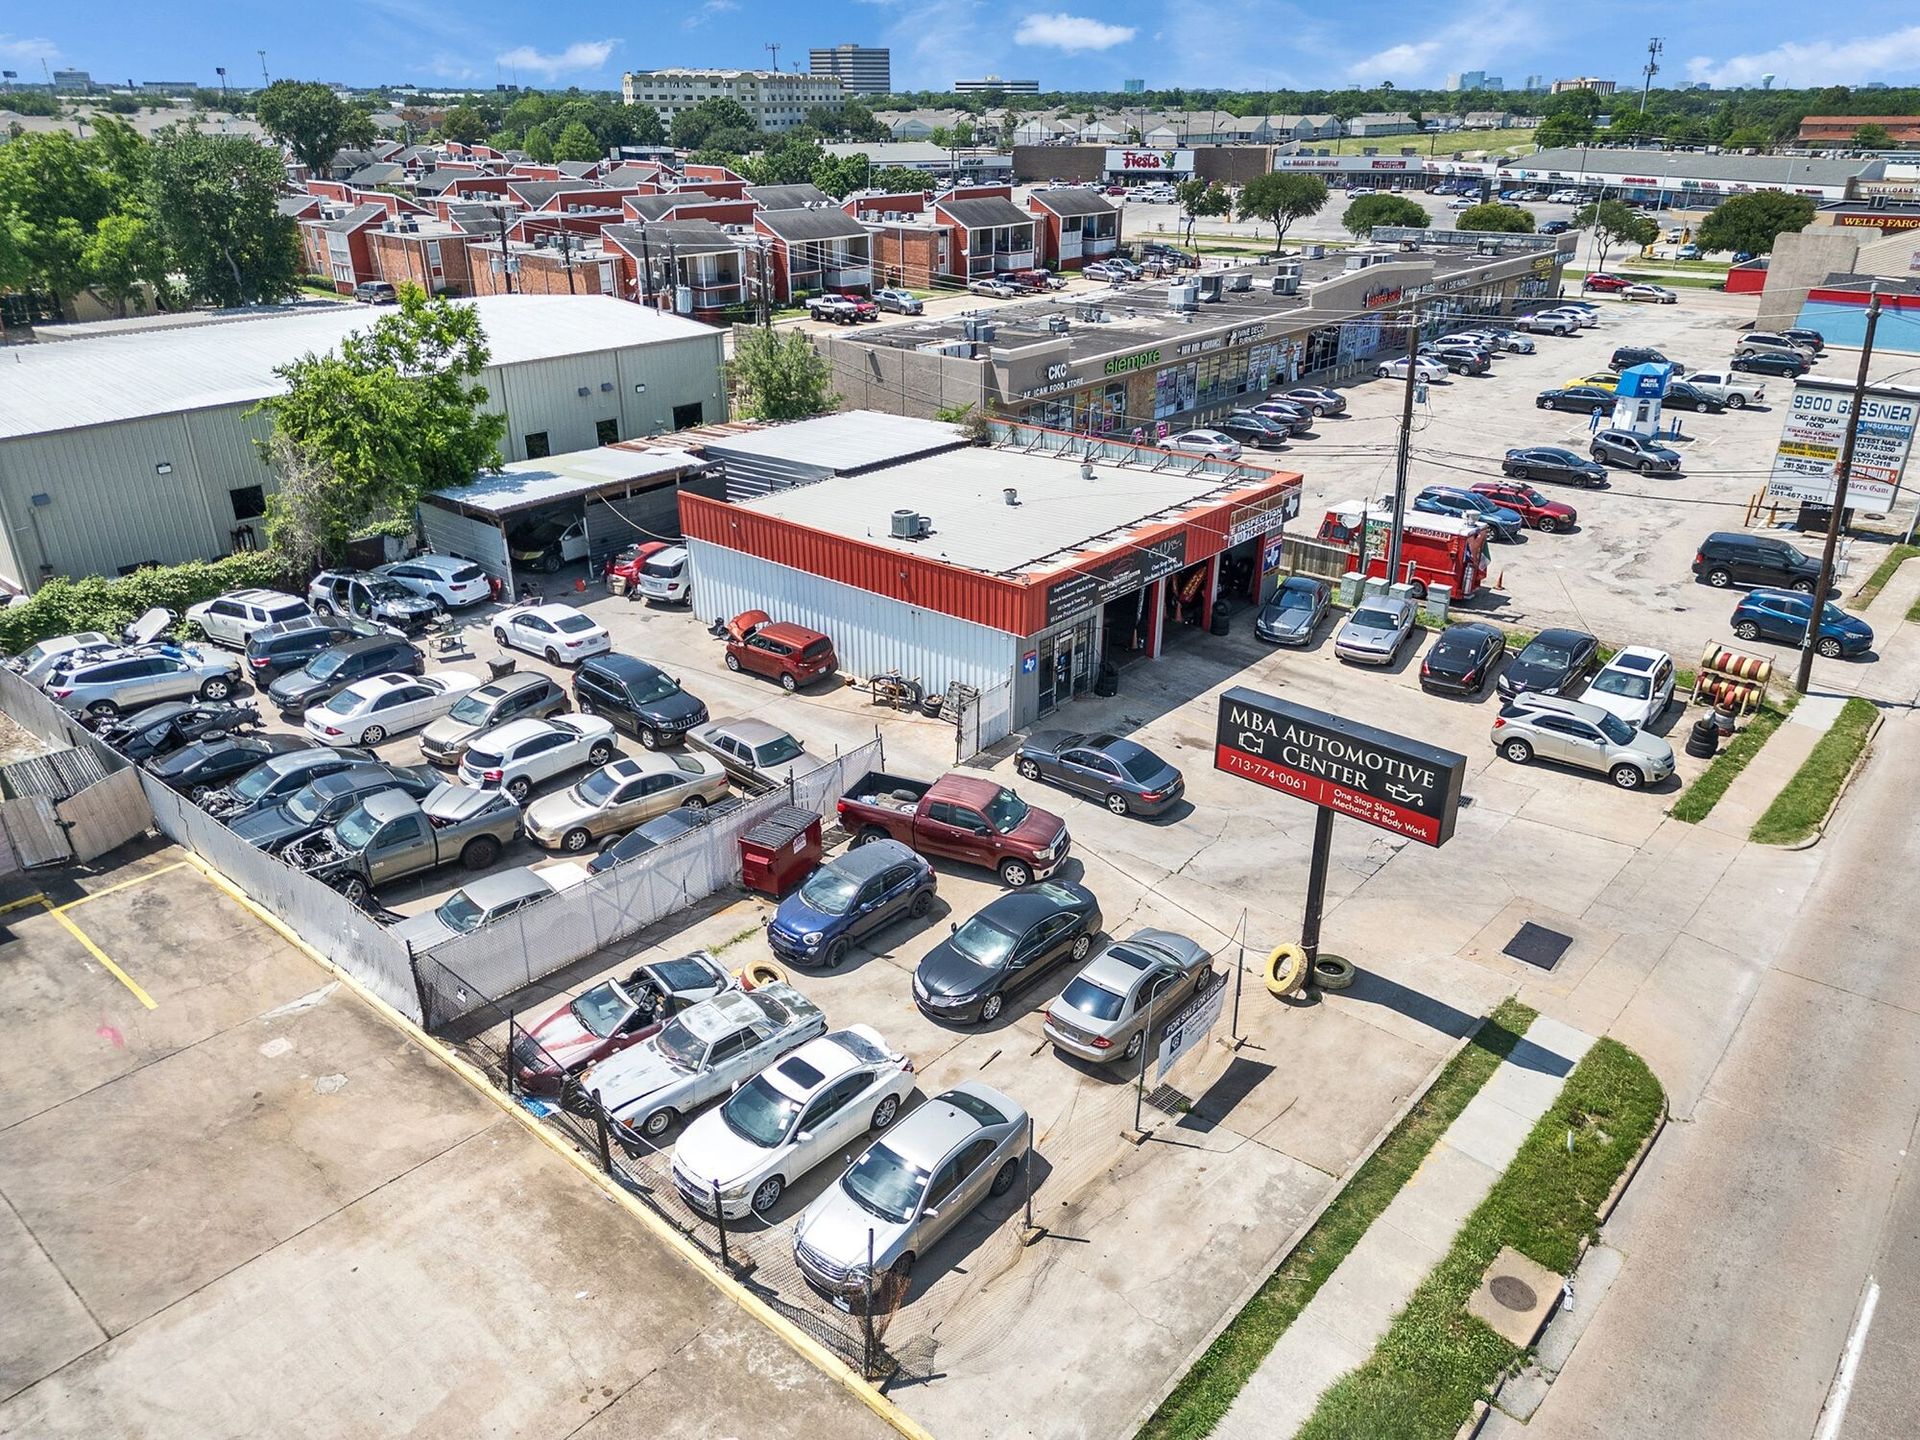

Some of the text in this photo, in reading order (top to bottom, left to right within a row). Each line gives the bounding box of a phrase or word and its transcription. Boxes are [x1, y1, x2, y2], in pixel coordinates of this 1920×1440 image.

[1122, 151, 1160, 169] Fiesta
[1844, 217, 1920, 228] WELLS FARG
[1104, 351, 1162, 375] siempre
[1048, 363, 1067, 380] CKC
[1794, 395, 1833, 412] 9900
[1809, 415, 1839, 425] AFRICAN
[1864, 422, 1911, 433] INSURANCE
[1813, 431, 1840, 439] AFRICAN
[1856, 443, 1896, 453] 13-774-3350
[1881, 439, 1903, 447] NAILS
[1853, 457, 1892, 467] 13-777-3118
[1871, 453, 1901, 463] CASHED
[1771, 484, 1793, 492] LEASING
[1769, 490, 1823, 502] 281-467-3535
[1237, 507, 1282, 532] INSPECTION
[1230, 706, 1435, 789] MBA AUTOMOTIVE
[1282, 746, 1370, 791] CENTER
[1334, 788, 1396, 817] One Stop Shop
[1332, 798, 1427, 838] Mechanic & Body Work
[1166, 1020, 1180, 1036] FOR
[1180, 1001, 1198, 1022] SALE
